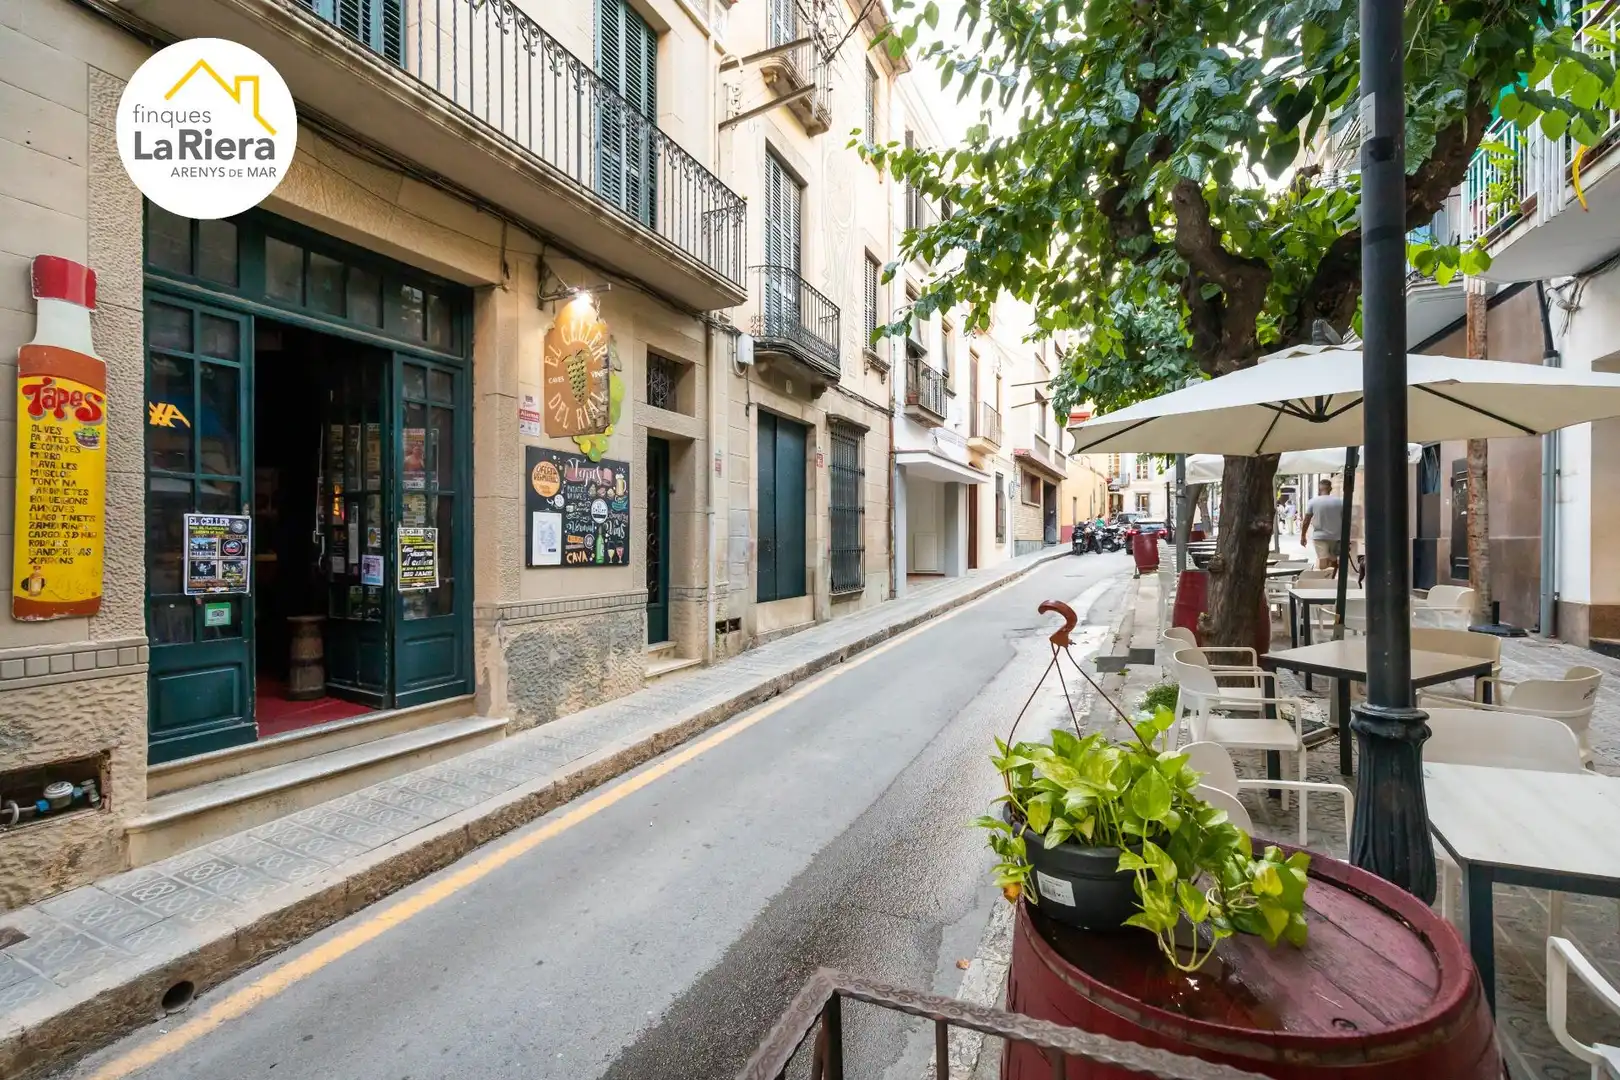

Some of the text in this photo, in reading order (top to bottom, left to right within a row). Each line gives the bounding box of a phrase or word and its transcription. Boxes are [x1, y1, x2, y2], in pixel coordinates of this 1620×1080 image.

[545, 345, 562, 368] EL
[548, 392, 608, 430] DEL RIAL
[32, 424, 62, 436] OLVES
[31, 434, 70, 444] PAATES
[30, 452, 61, 461] MRRO
[31, 460, 78, 470] AVALES
[30, 469, 72, 478] MSCLO
[31, 478, 77, 486] TONYNA
[28, 531, 70, 539] CARGOS
[566, 550, 589, 564] CAVA
